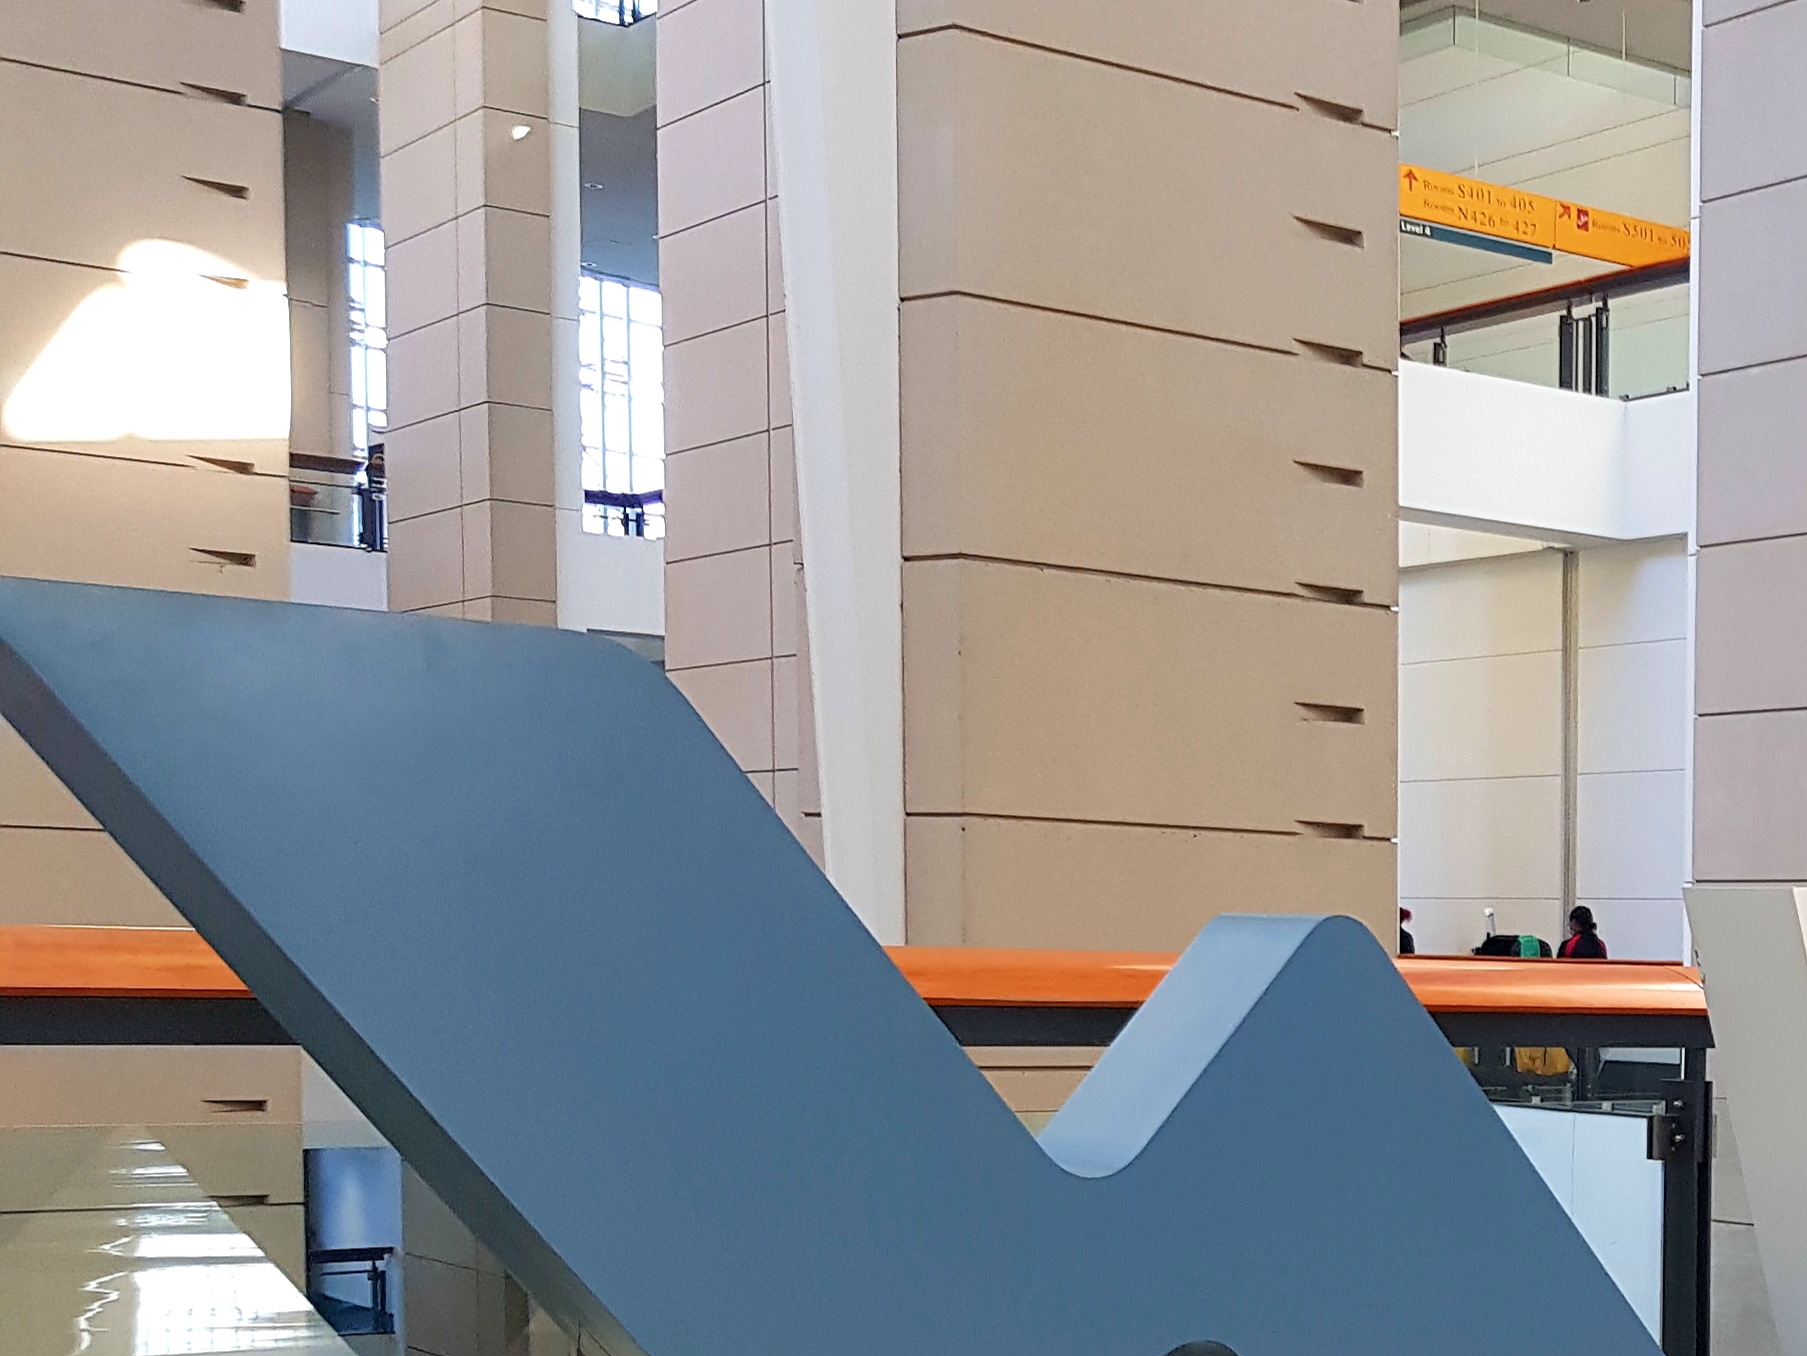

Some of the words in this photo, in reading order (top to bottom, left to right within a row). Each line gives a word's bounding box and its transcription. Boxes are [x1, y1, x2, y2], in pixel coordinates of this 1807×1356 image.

[1457, 183, 1492, 205] S401
[1510, 195, 1535, 214] 405
[1400, 219, 1424, 235] Level
[1458, 205, 1496, 229] N426
[1513, 219, 1538, 238] 427
[1622, 221, 1654, 242] S501
